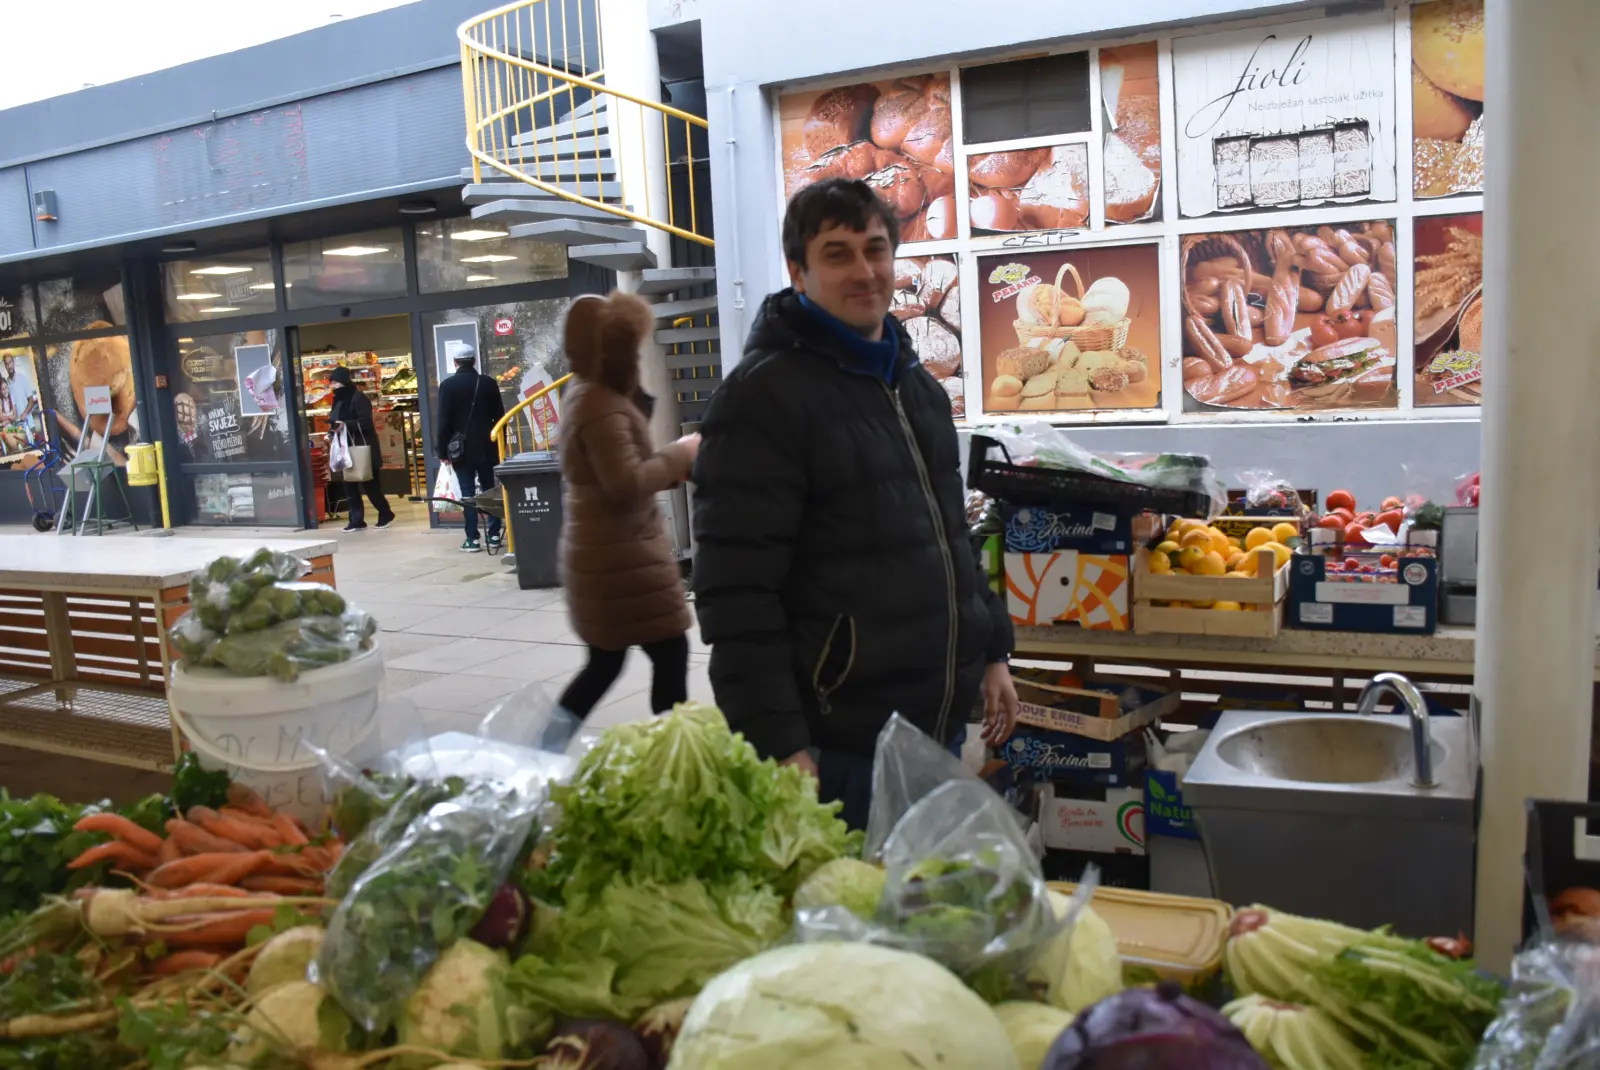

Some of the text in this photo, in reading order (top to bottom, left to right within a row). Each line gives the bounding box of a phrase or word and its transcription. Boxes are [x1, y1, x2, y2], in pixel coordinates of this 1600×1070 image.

[1185, 34, 1312, 139] fioli
[1248, 88, 1384, 112] Neizbježan sastojak užitka
[993, 275, 1042, 303] PEKARNA
[1434, 369, 1482, 393] PEKAR
